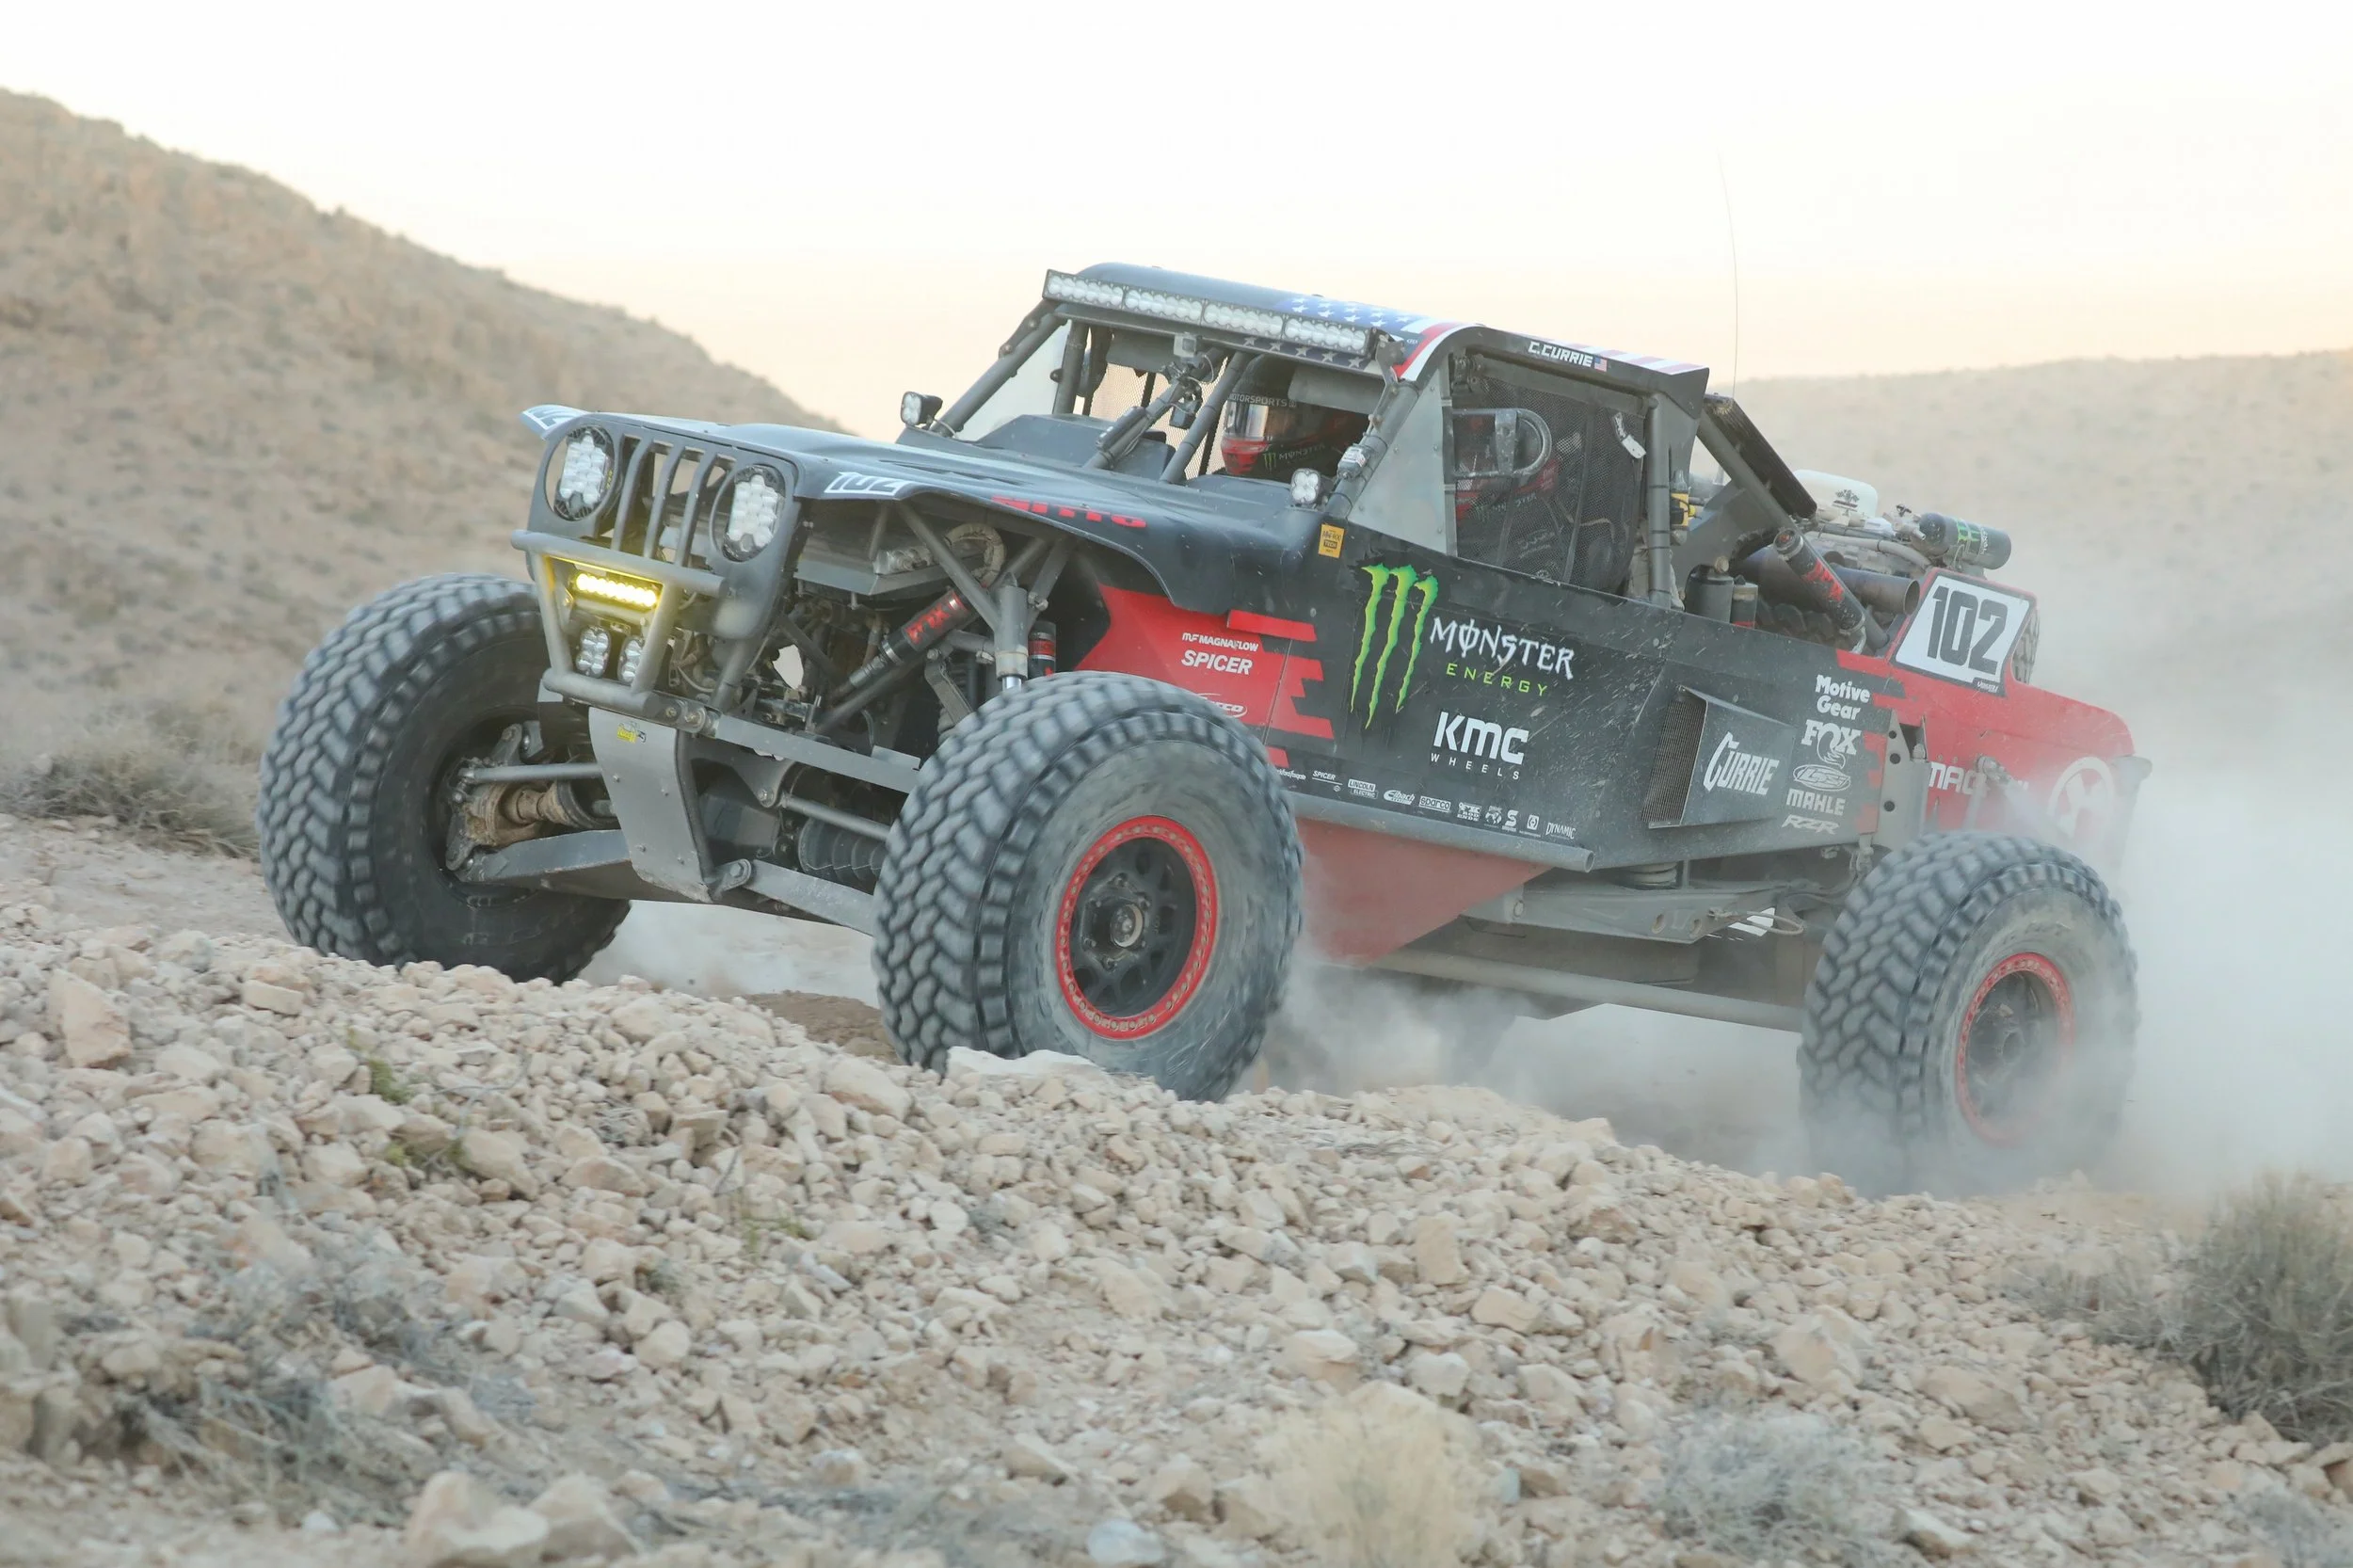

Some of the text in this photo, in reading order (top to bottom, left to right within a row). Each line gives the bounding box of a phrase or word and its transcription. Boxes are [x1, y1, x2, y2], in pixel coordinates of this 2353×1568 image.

[1528, 341, 1594, 368] C.CURRIE
[1199, 635, 1258, 651] MAGNAFLOW
[1928, 585, 2008, 675] 102
[1430, 616, 1575, 680] MONSTER
[1181, 649, 1253, 675] SPICER
[1446, 663, 1547, 696] ENERGY
[1815, 674, 1870, 703] Motive
[1817, 695, 1861, 720] Gear
[1801, 719, 1862, 769] FOX
[1312, 770, 1337, 781] SPICER
[1431, 753, 1519, 780] WHEELS
[1703, 731, 1780, 796] CURRIE
[1349, 779, 1375, 792] LINCOLN
[1420, 797, 1450, 809] sparco
[1786, 789, 1846, 816] MAHLE
[1545, 822, 1577, 840] DYNAMIC
[1782, 814, 1840, 835] RZR
